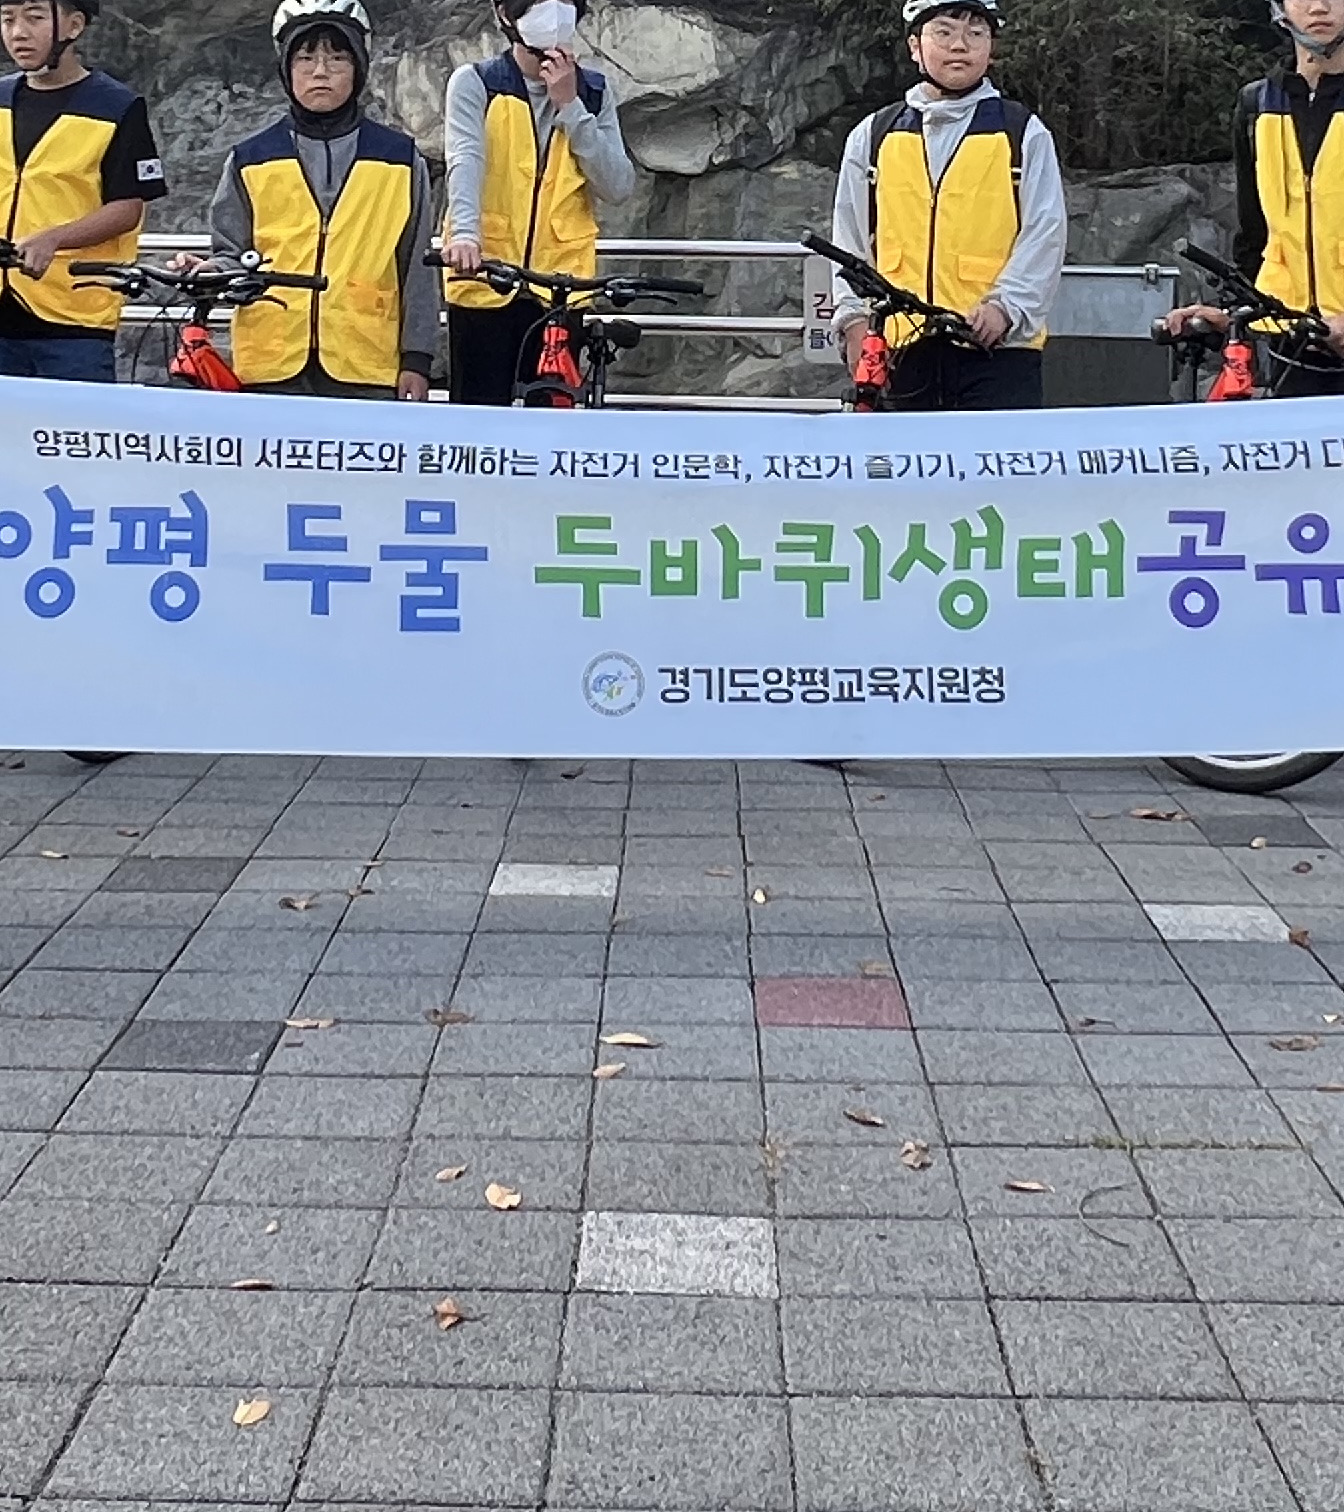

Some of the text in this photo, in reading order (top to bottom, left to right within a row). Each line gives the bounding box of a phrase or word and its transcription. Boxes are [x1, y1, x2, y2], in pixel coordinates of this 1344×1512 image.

[32, 429, 242, 468] 양평지역사회의
[254, 438, 408, 474] 서포터즈와
[417, 444, 540, 477] 함께하는
[549, 450, 640, 478] 자전거
[652, 454, 752, 484] 인문학,
[764, 454, 853, 480] 자전거
[864, 454, 966, 482] 즐기기,
[976, 450, 1068, 477] 자전거
[1077, 445, 1210, 477] 메커니즘,
[1219, 440, 1311, 472] 자전거
[264, 499, 488, 633] 두물
[657, 666, 1006, 704] 경기도양평교육지원청
